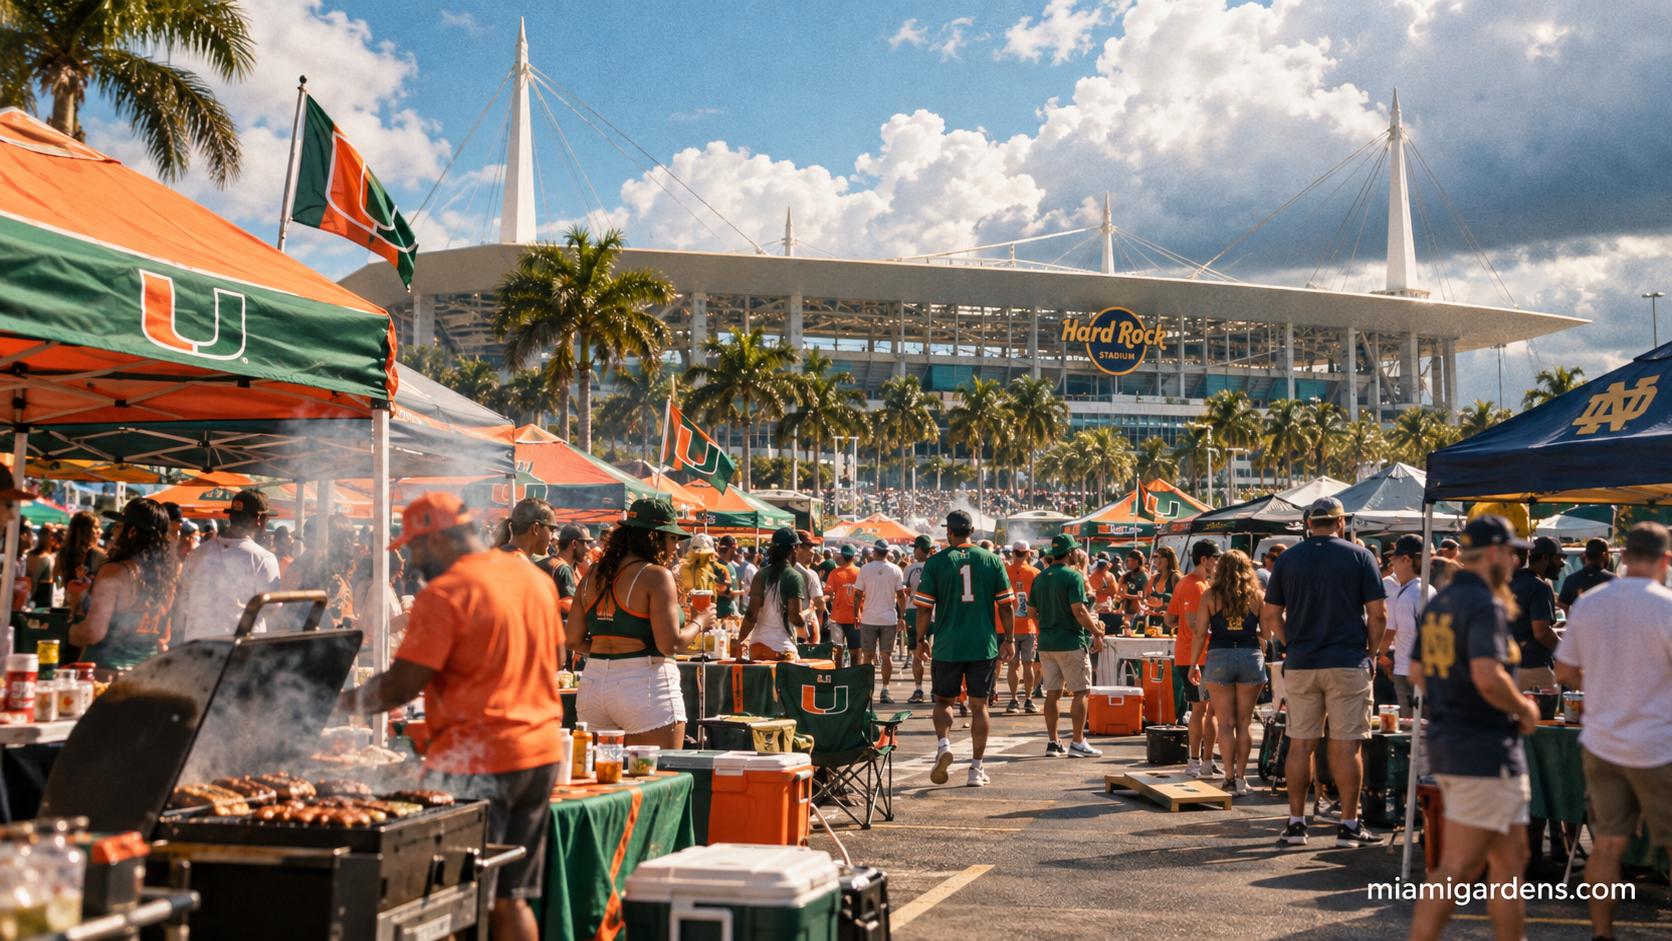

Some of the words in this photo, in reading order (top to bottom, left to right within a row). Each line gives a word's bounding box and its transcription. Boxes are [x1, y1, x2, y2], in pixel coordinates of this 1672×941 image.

[139, 268, 246, 361] U
[1061, 318, 1116, 343] Hard
[1117, 320, 1167, 350] Rock
[1099, 351, 1135, 360] STADIUM
[674, 423, 721, 475] U
[959, 564, 975, 602] 1
[801, 684, 848, 715] U
